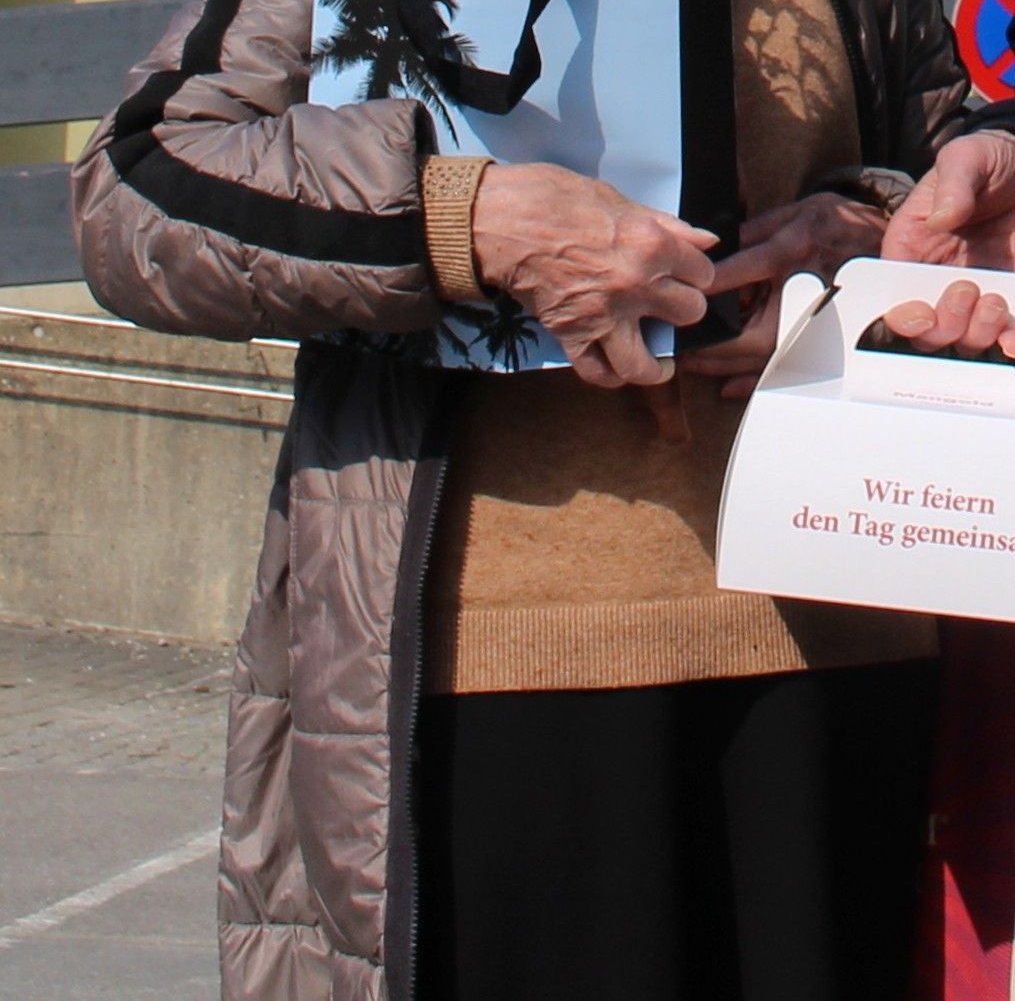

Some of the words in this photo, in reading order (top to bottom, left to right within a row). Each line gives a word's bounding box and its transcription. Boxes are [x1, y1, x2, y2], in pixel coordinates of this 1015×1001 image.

[863, 478, 915, 506] Wir
[919, 485, 995, 515] feiern
[792, 506, 839, 533] den
[848, 511, 895, 546] Tag
